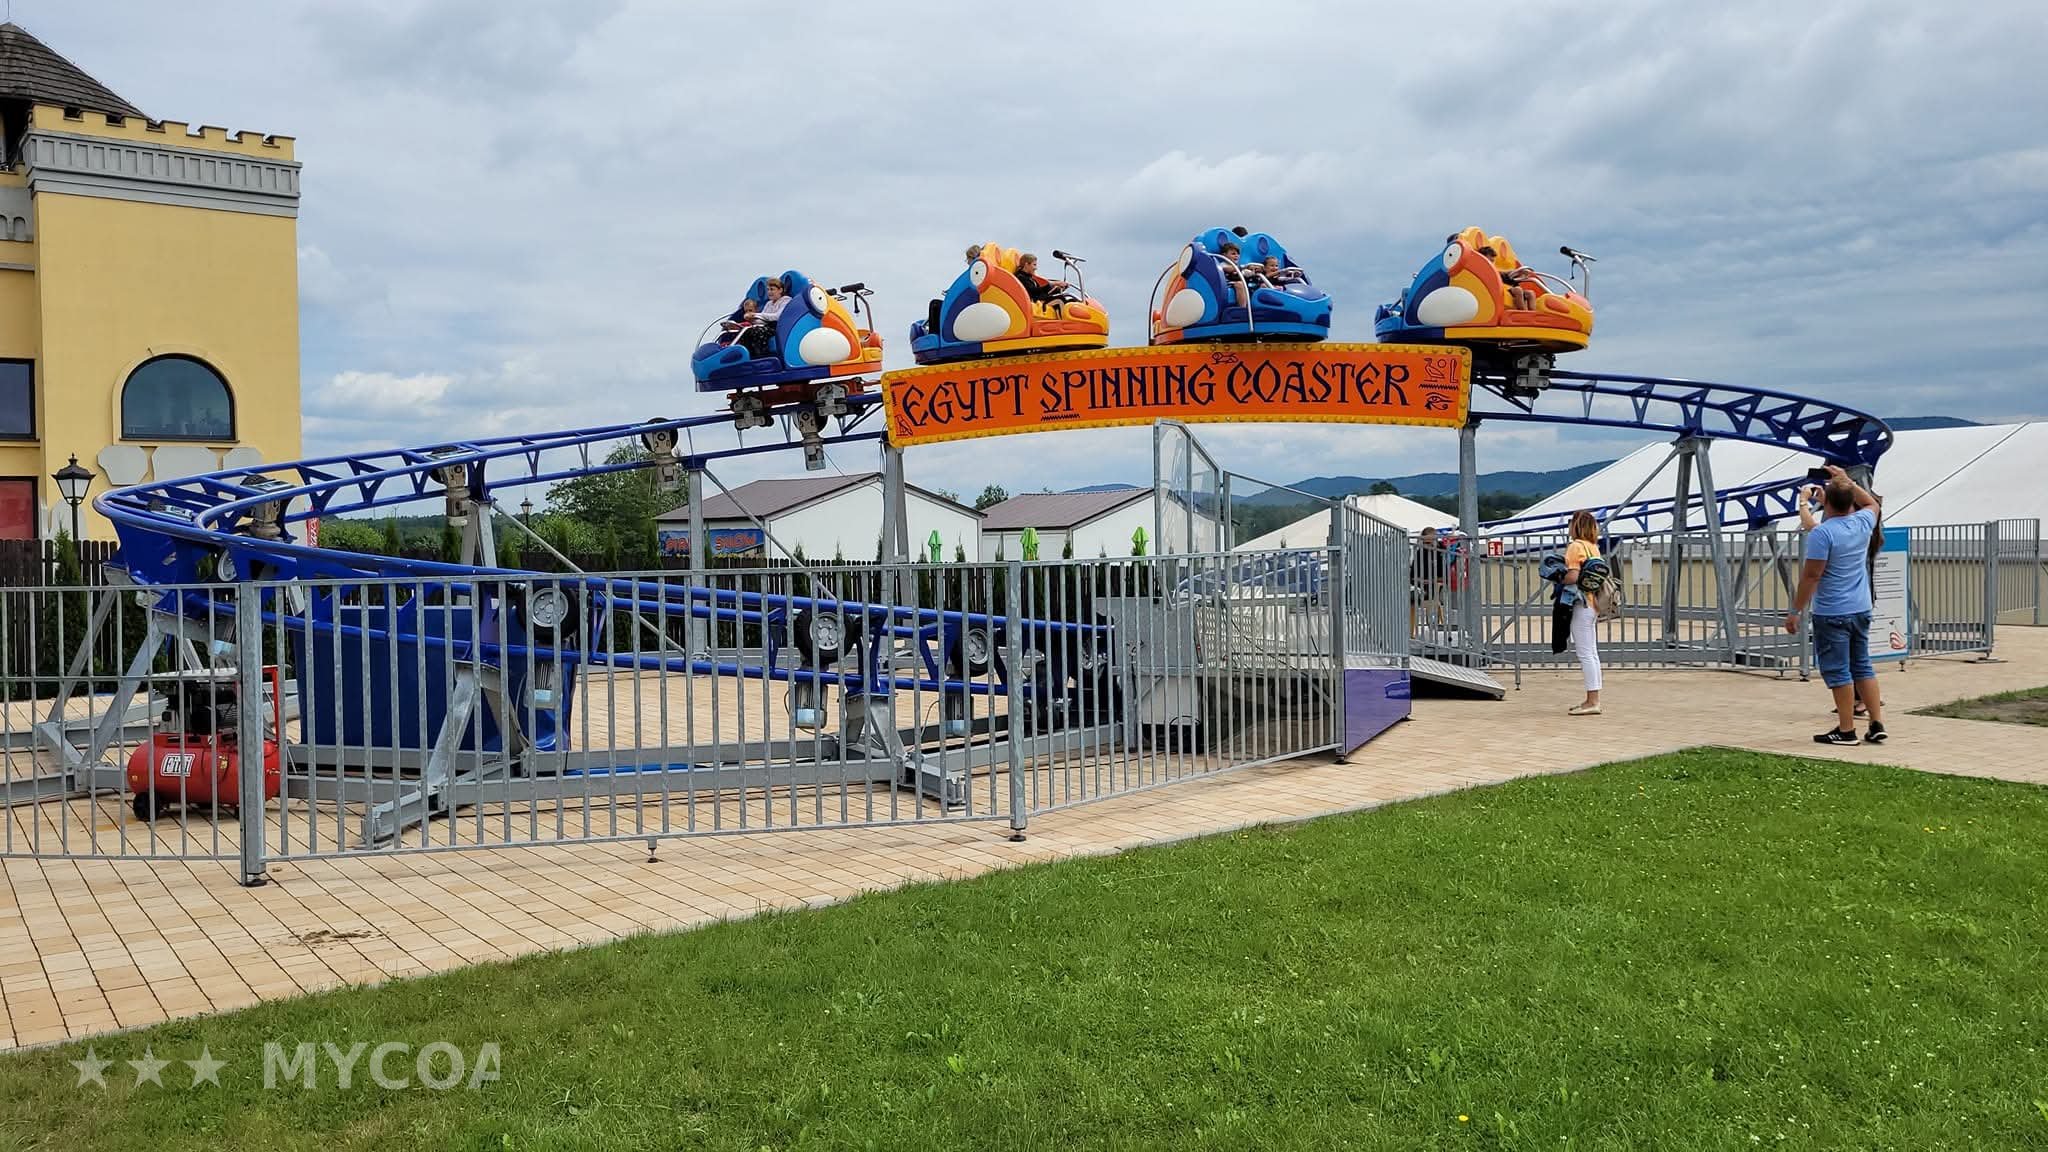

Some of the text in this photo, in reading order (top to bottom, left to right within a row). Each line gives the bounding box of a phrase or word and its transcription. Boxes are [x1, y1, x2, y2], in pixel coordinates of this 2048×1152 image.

[902, 359, 1411, 427] EGYPT SPINNING COASTER
